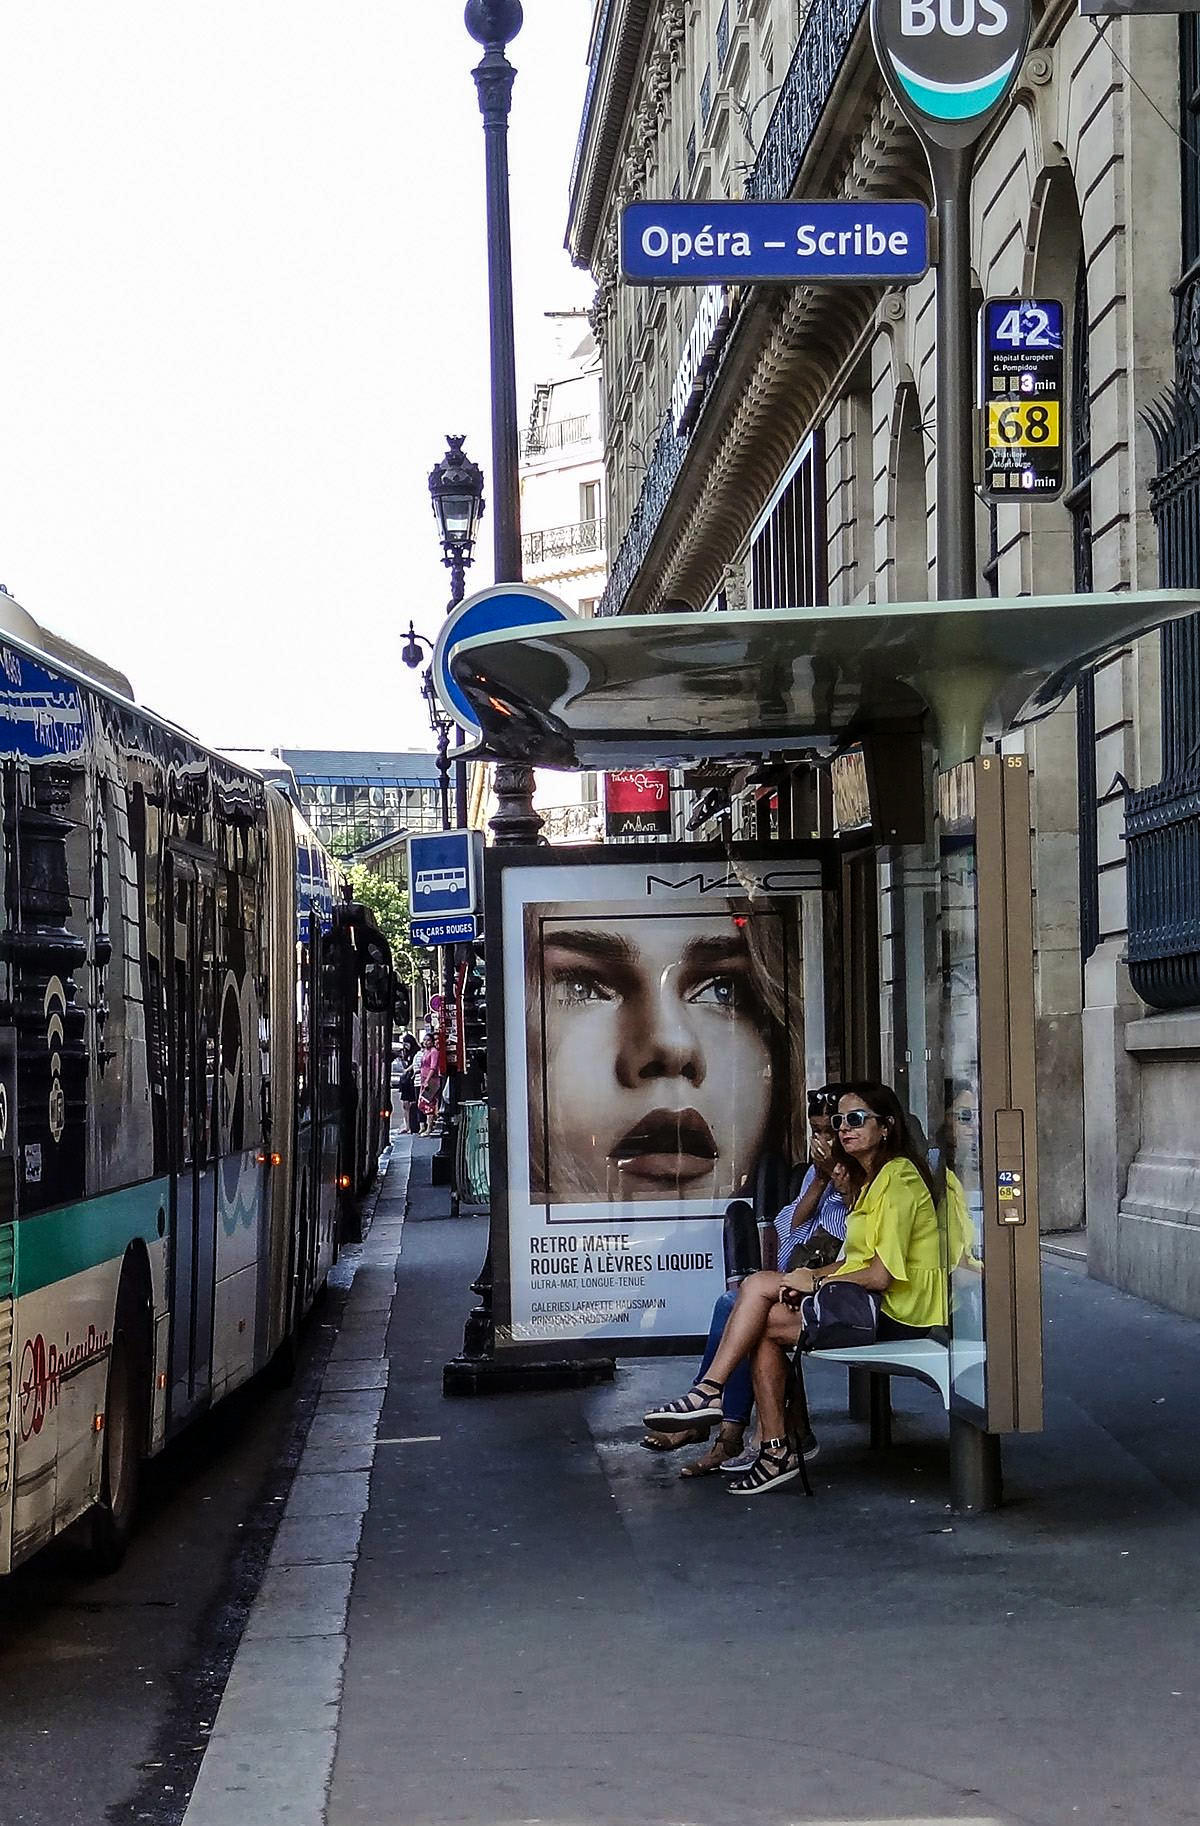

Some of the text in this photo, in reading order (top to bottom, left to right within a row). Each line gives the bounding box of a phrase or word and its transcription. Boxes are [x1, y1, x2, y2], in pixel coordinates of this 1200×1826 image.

[900, 0, 1008, 37] BUS
[641, 225, 751, 264] Opéra
[796, 223, 909, 257] Scribe
[996, 309, 1049, 346] 42
[993, 354, 1054, 362] Hôpital Européen
[1002, 364, 1038, 372] Pompidou
[1020, 373, 1056, 392] 3 min
[998, 405, 1050, 443] 68
[1034, 476, 1056, 487] min
[983, 759, 991, 770] 9
[1007, 756, 1022, 768] 55
[426, 926, 444, 936] CARS
[445, 923, 473, 935] ROUGES
[999, 1172, 1012, 1181] 42
[999, 1187, 1012, 1197] 68
[530, 1234, 630, 1254] RETRO MATTE
[530, 1252, 714, 1275] ROUGE À LÈVRES LIQUIDE
[580, 1276, 646, 1288] LONGUE-TENUE
[531, 1298, 666, 1313] GALERIES LAFAYETTE HAUSSMANN
